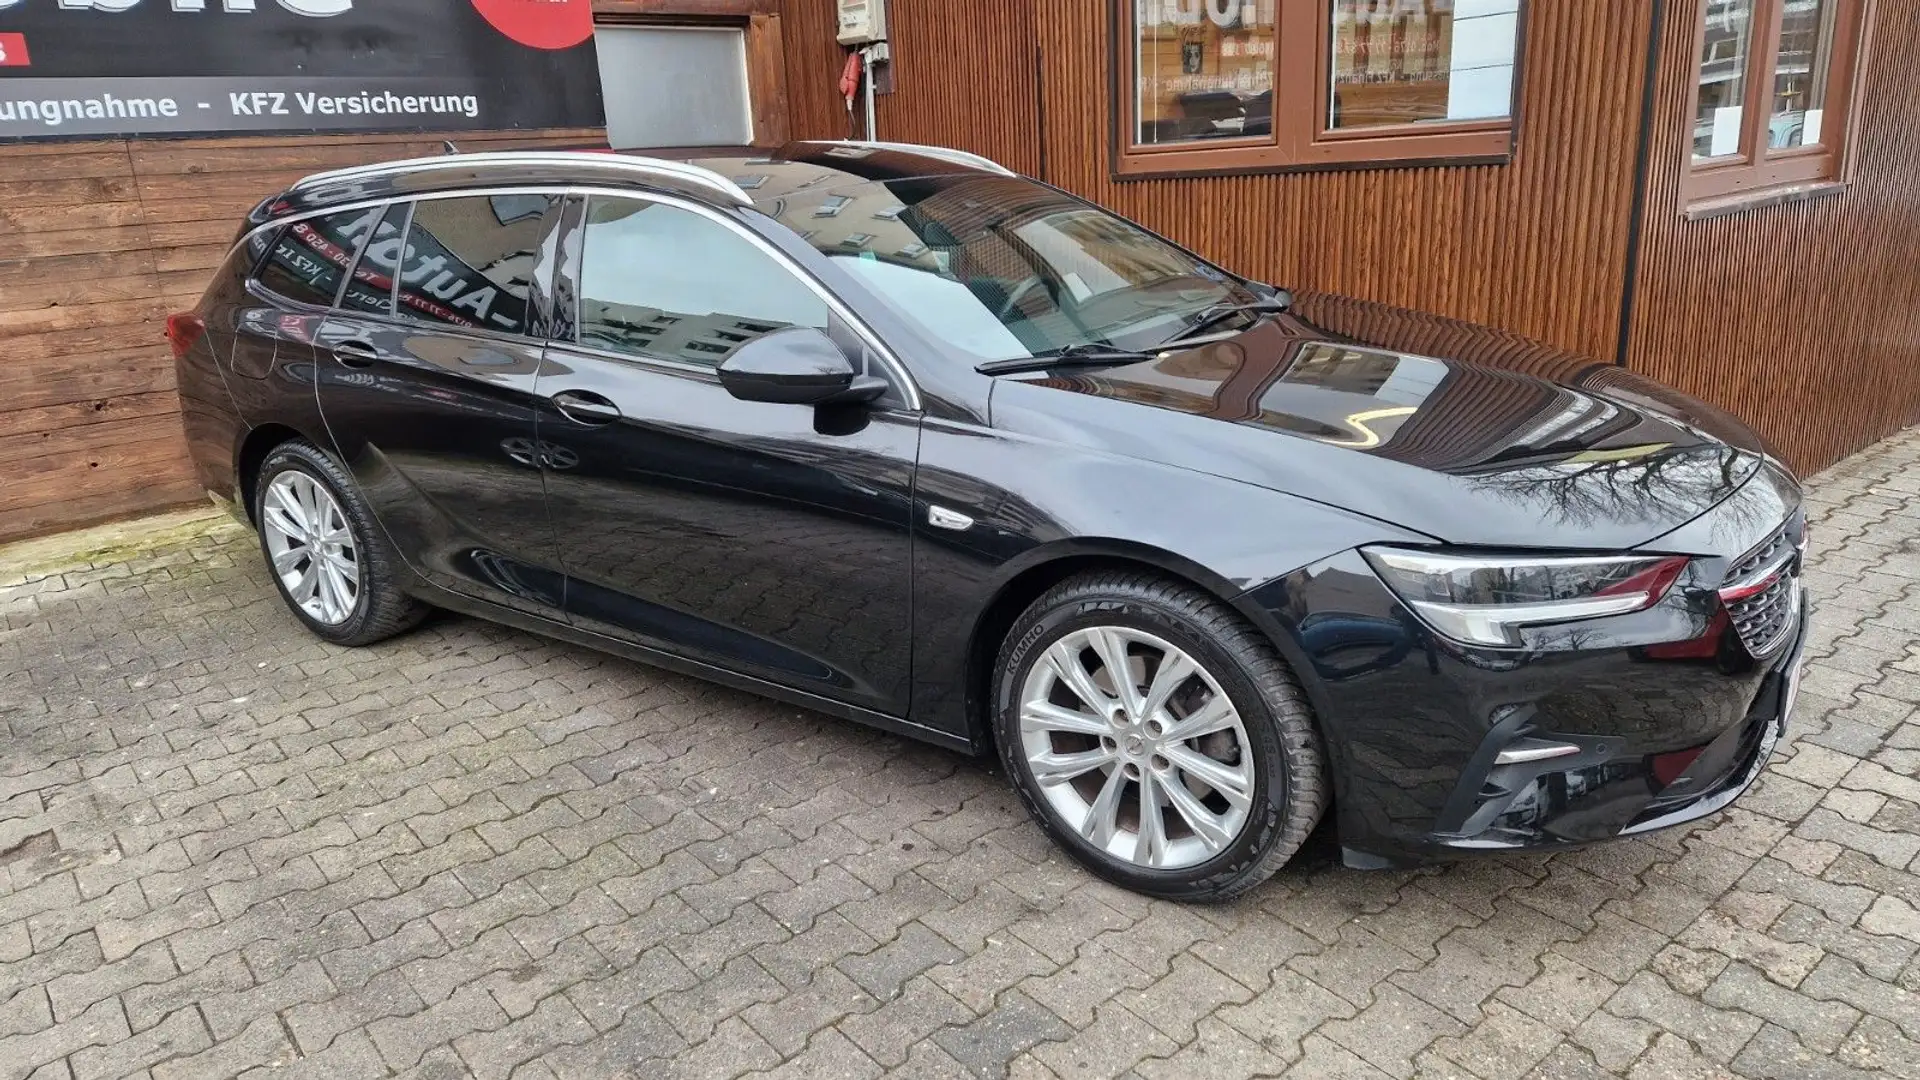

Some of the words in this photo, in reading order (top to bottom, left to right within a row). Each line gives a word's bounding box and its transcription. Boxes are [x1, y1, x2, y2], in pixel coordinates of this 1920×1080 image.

[0, 93, 178, 126] ungnahme
[230, 92, 290, 116] KFZ
[295, 91, 479, 118] Versicherung
[1006, 624, 1044, 675] KUMHO
